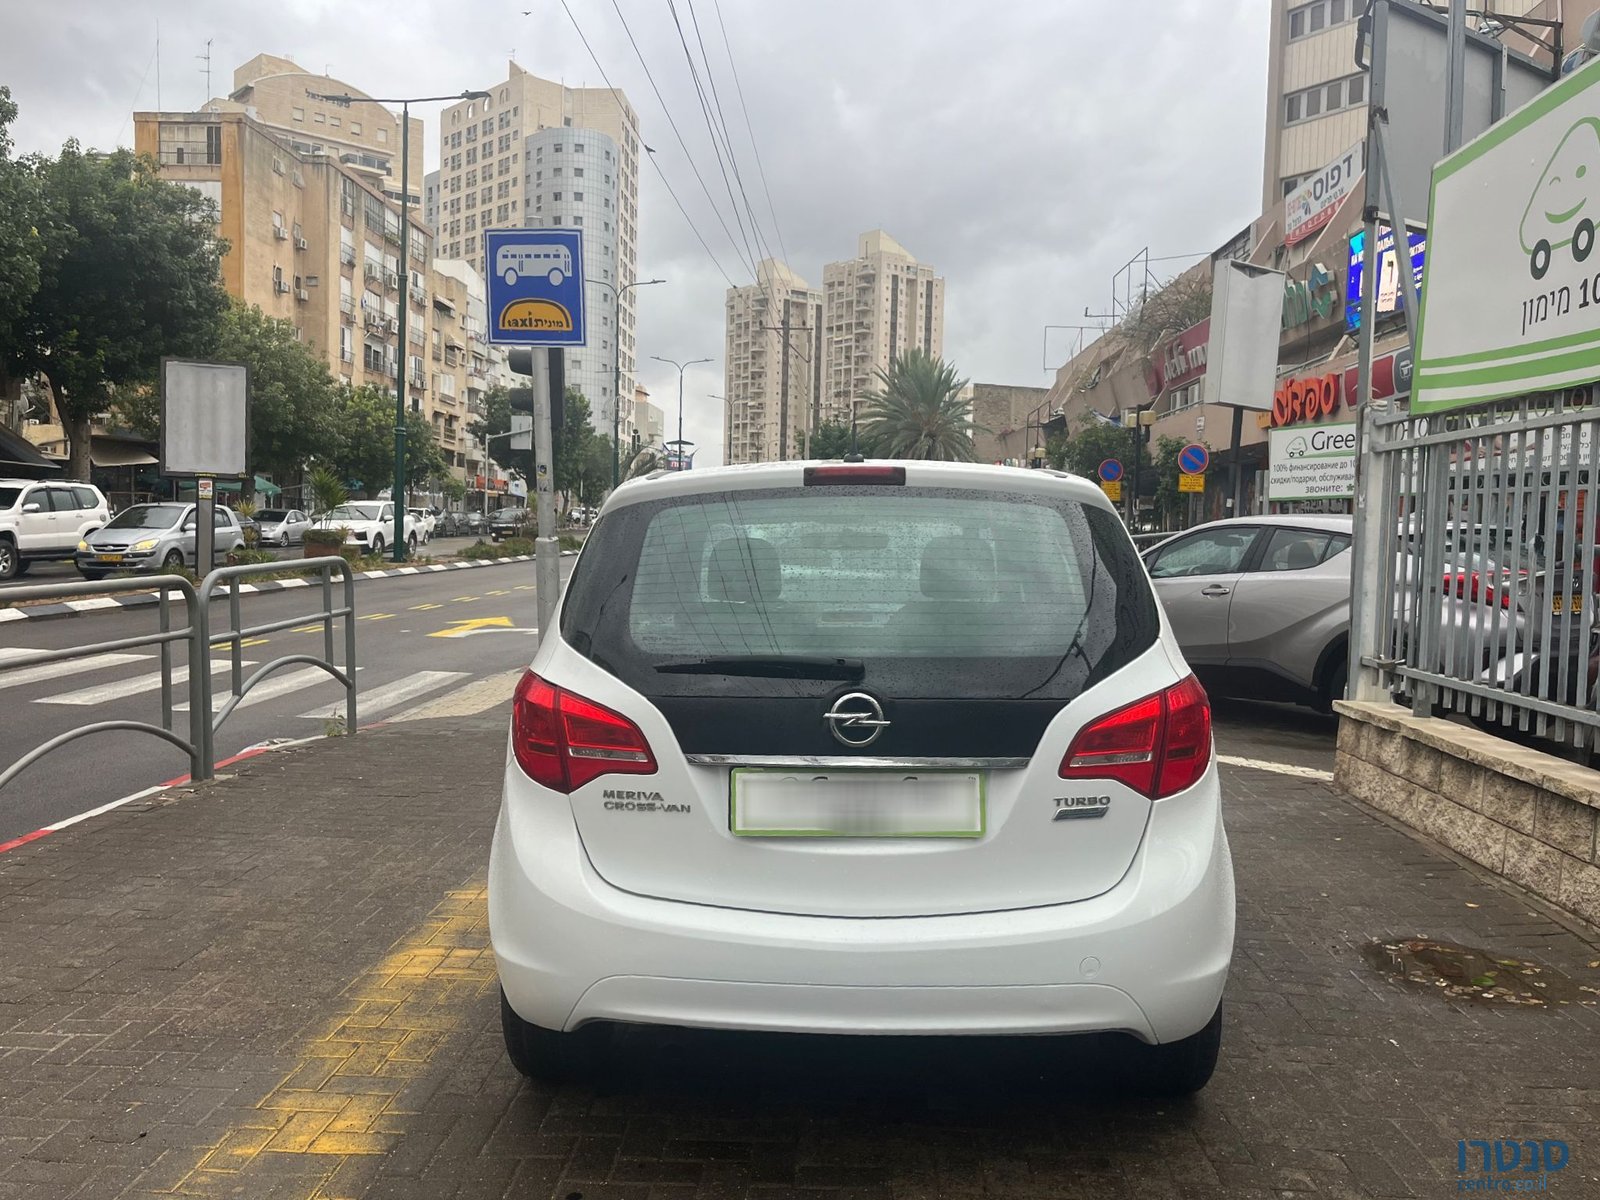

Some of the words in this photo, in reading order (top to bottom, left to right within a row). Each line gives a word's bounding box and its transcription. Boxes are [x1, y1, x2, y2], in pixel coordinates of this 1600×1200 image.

[1312, 154, 1353, 201] דפוס
[1521, 286, 1571, 336] מימון
[507, 311, 533, 328] taxi
[533, 318, 564, 328] מונית
[1273, 463, 1288, 473] 100%
[1289, 462, 1339, 473] финансирование
[1339, 461, 1348, 470] до
[1305, 484, 1343, 494] звоните:
[603, 789, 665, 802] MERIVA
[1053, 795, 1111, 807] TURBO
[603, 800, 691, 814] CROSS-VAN
